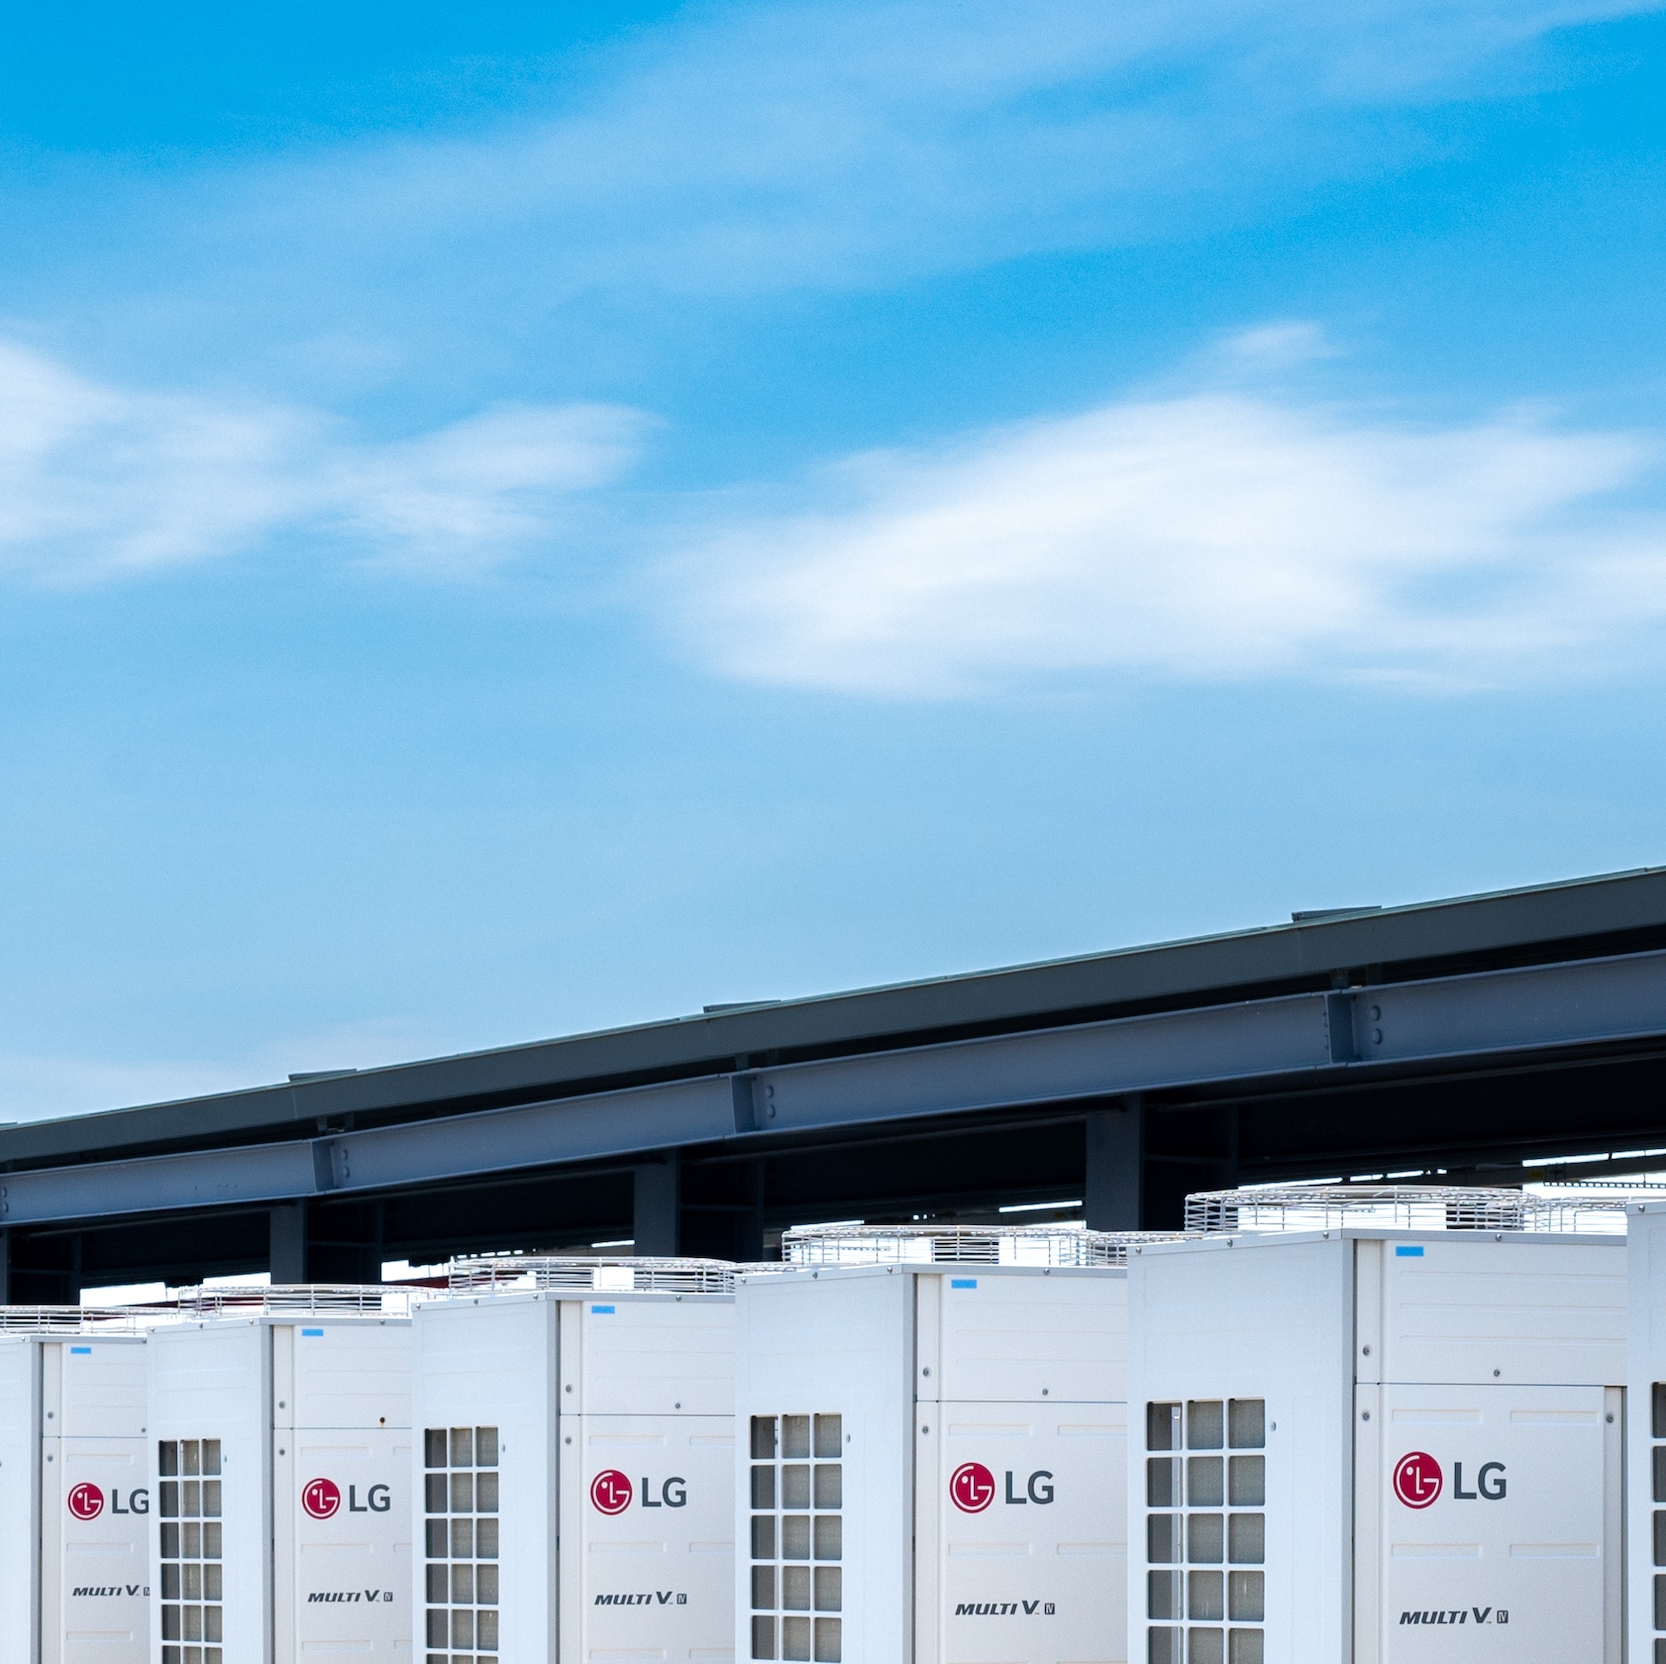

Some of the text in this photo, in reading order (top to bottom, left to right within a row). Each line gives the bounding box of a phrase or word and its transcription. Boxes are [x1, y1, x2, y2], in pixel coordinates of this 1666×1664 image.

[1005, 1470, 1054, 1505] LG
[1453, 1461, 1507, 1501] LG
[111, 1488, 149, 1515] LG
[348, 1483, 391, 1513] LG
[641, 1476, 687, 1508] LG
[72, 1587, 123, 1597] MULTI
[307, 1592, 361, 1603] MULTI
[594, 1593, 653, 1606] MULTI
[954, 1603, 1018, 1616] MULTI
[1399, 1610, 1468, 1625] MULTI
